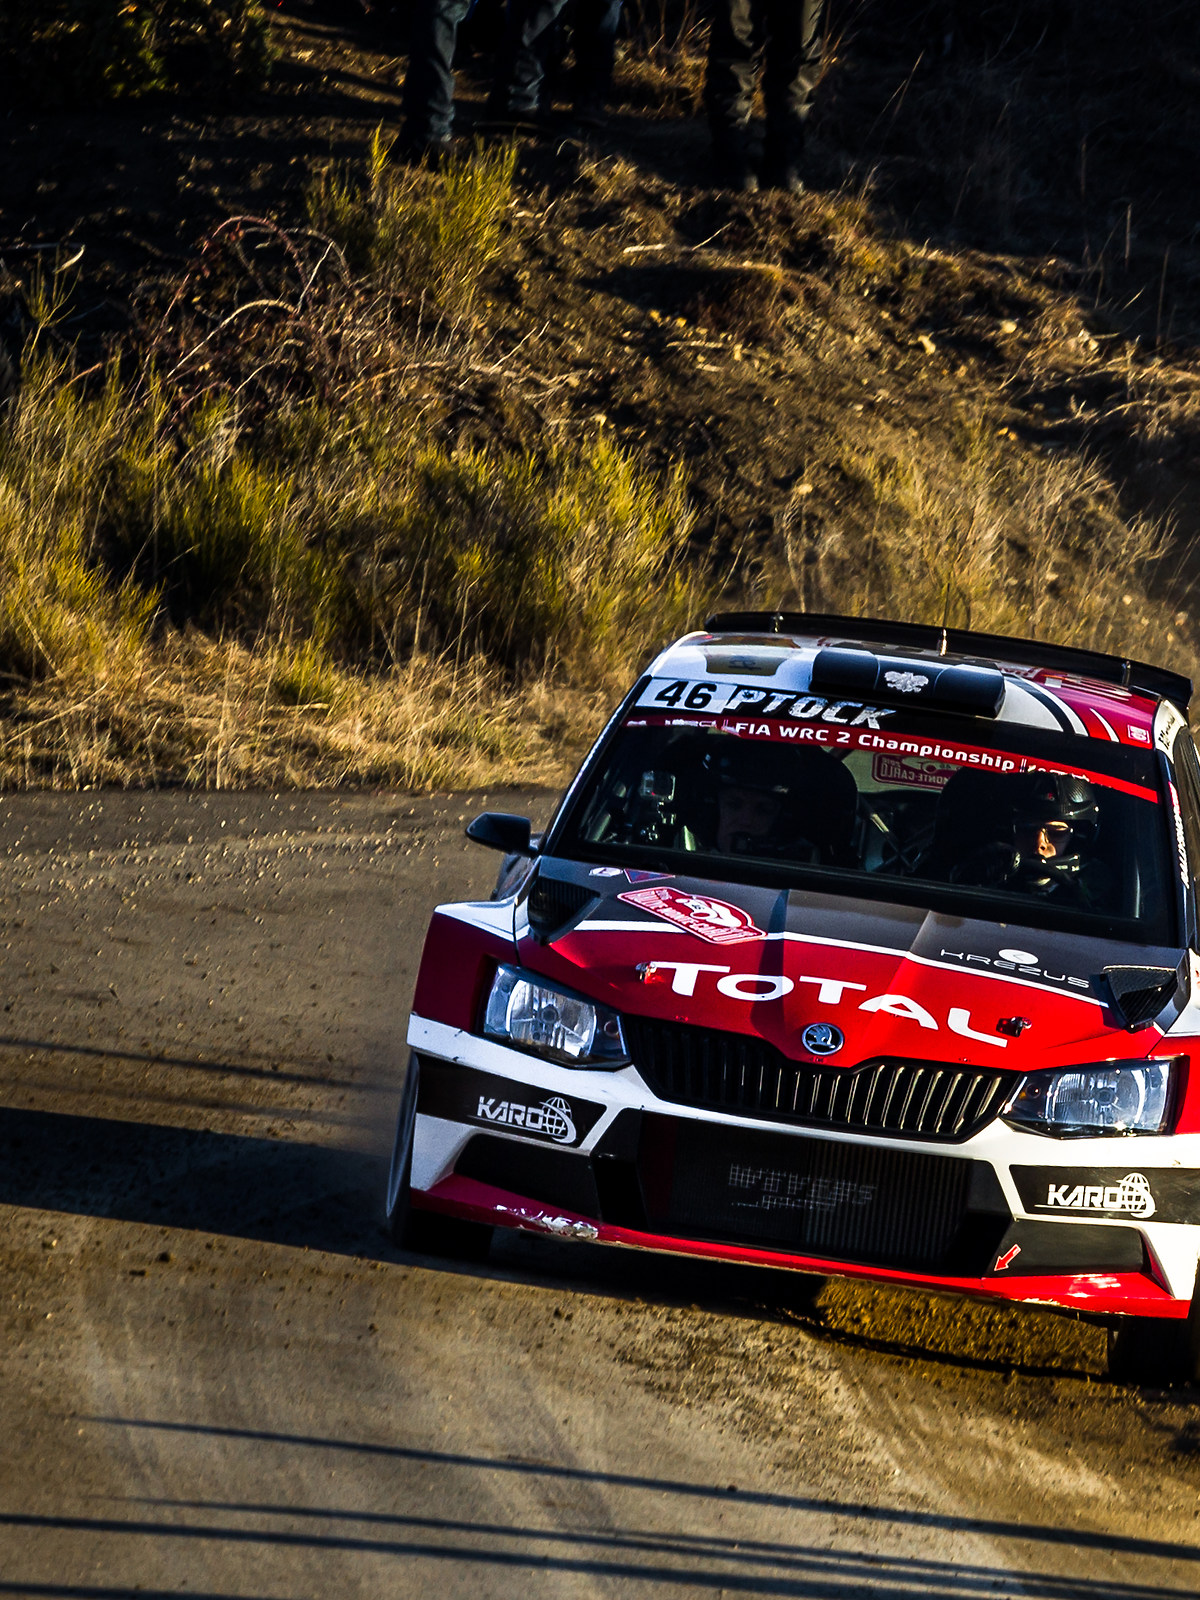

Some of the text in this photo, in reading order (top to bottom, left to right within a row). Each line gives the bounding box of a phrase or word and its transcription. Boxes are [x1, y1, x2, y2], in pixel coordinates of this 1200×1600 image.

[654, 680, 897, 730] 46 PTOCK
[736, 722, 772, 736] FIA
[779, 725, 829, 741] WRC
[836, 731, 850, 744] 2
[858, 733, 1015, 772] Championship
[649, 960, 1008, 1048] TOTAL
[477, 1095, 545, 1130] KARO
[1047, 1183, 1121, 1208] KARO
